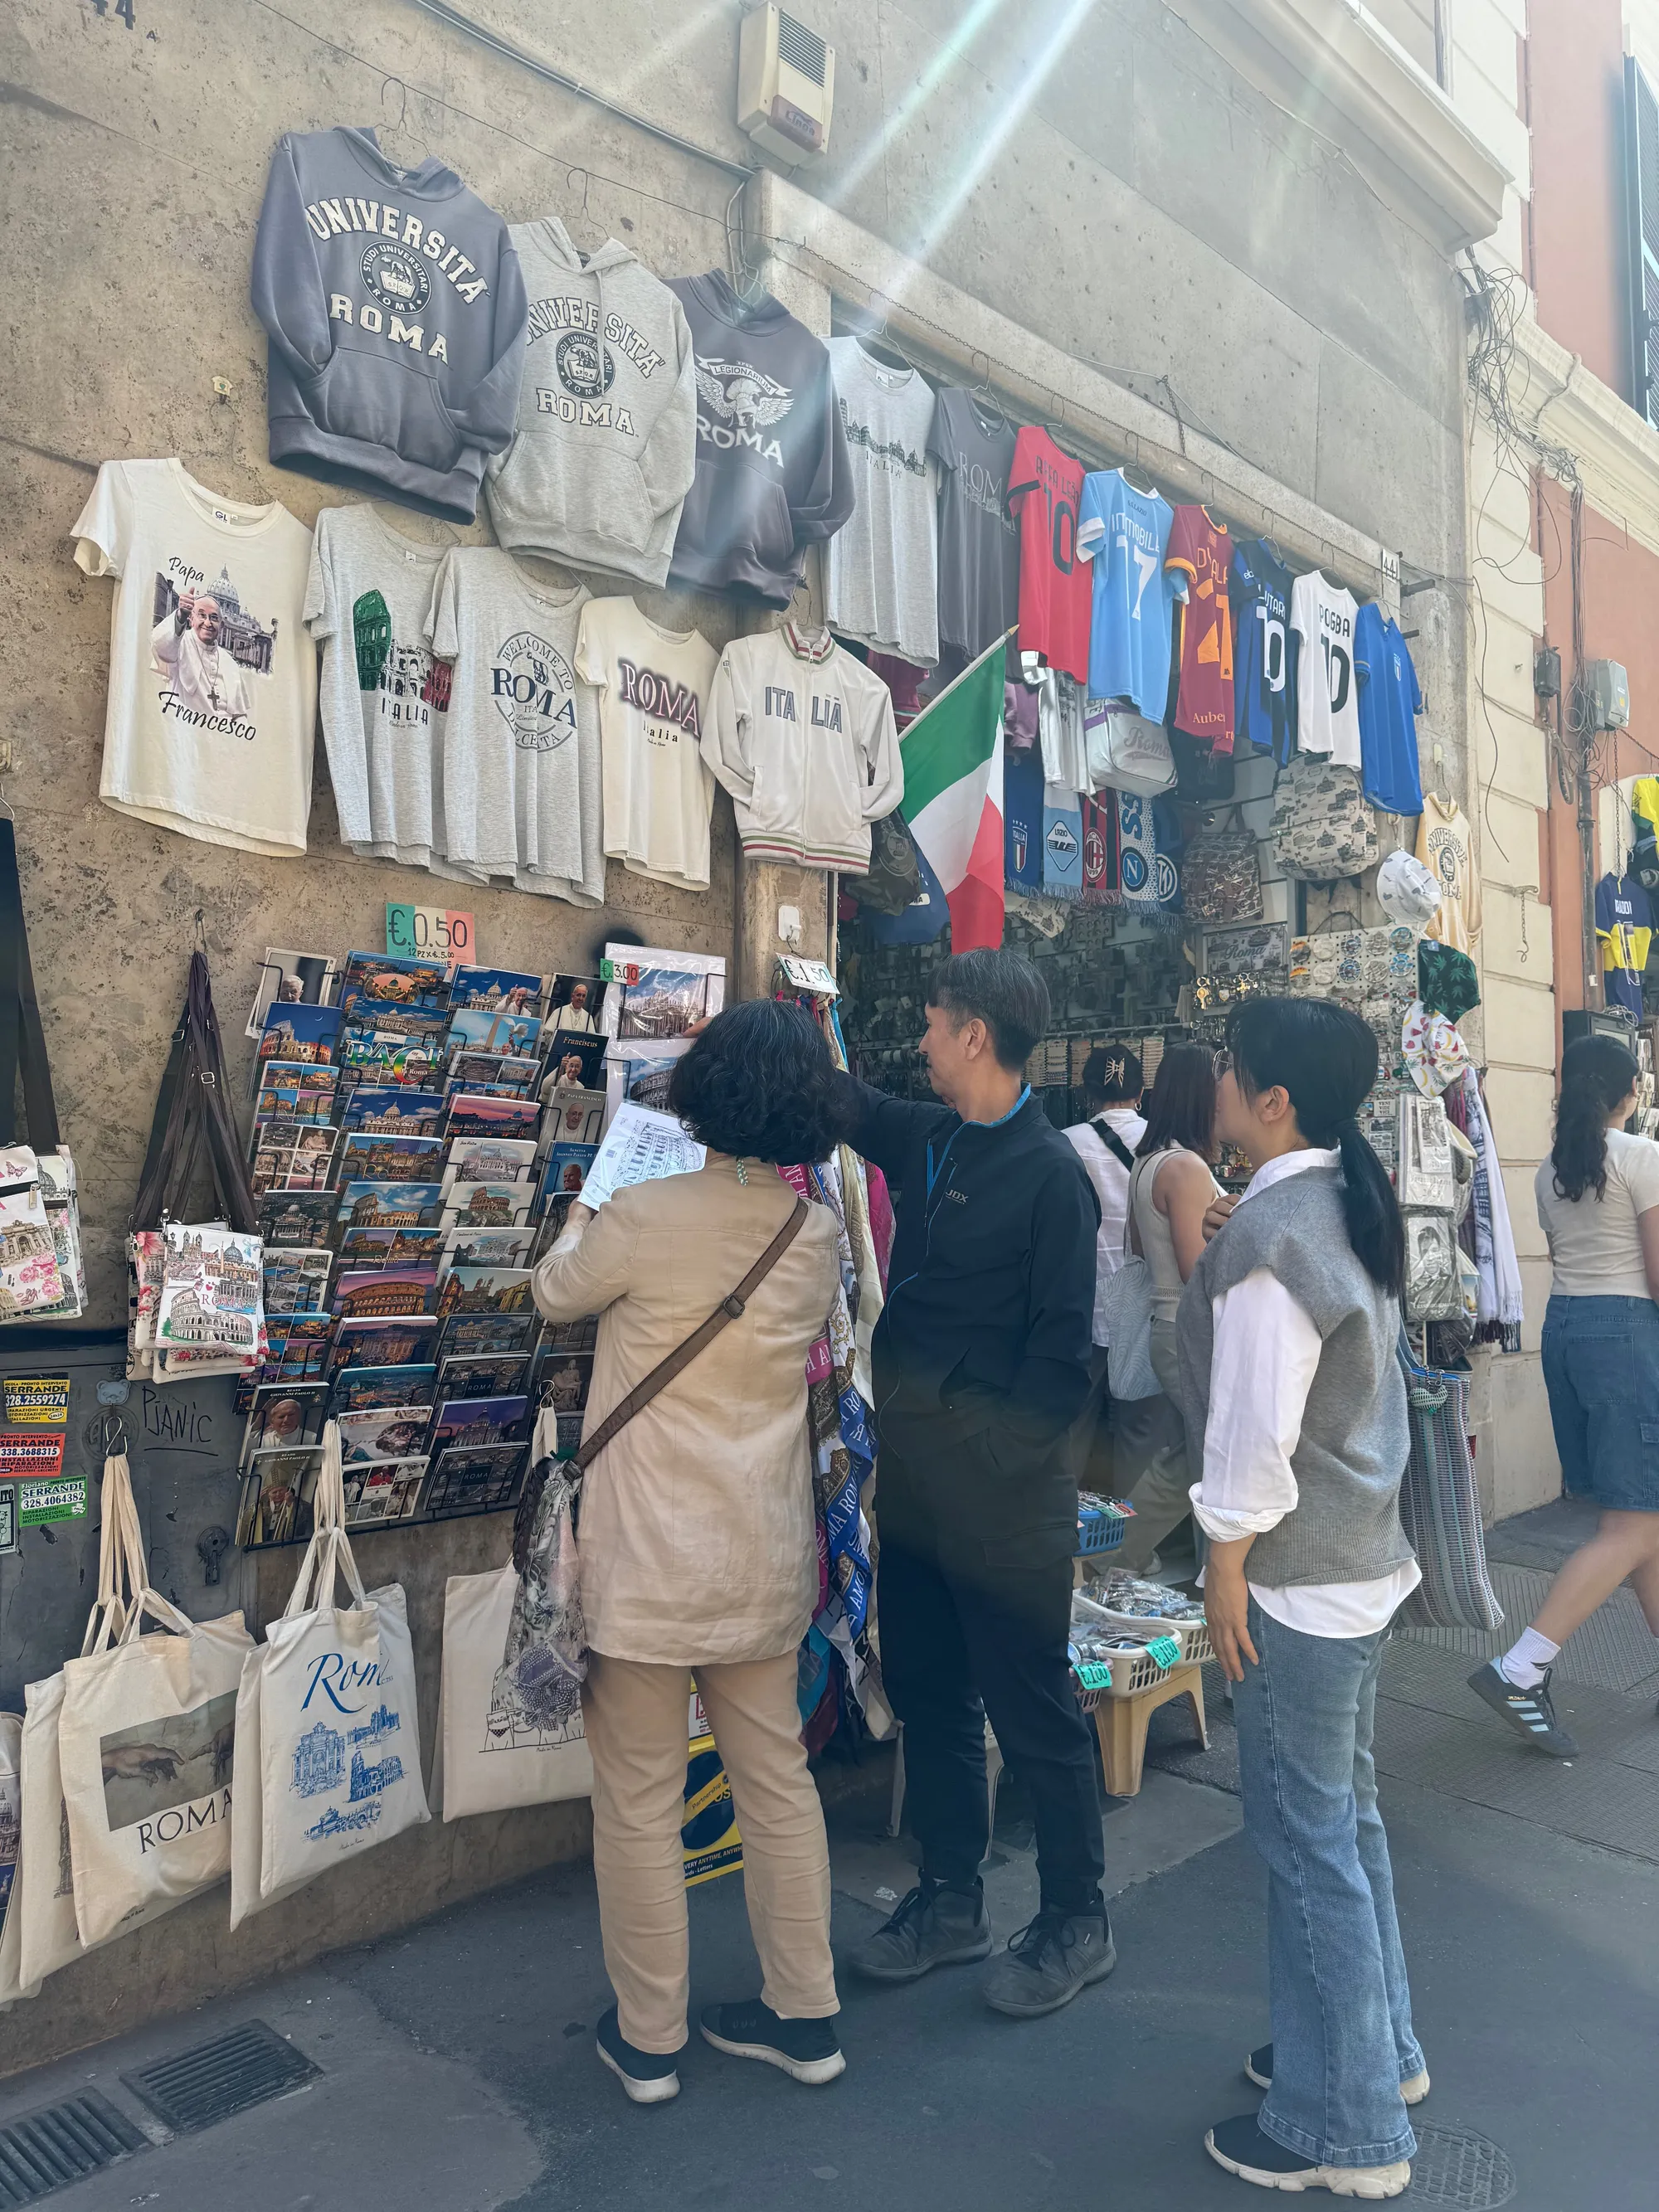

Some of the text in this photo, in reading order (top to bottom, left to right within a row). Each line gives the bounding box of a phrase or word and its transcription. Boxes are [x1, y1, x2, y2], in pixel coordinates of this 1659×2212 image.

[362, 246, 428, 292] STUDI UNIVERSITARI
[372, 289, 416, 312] ROMA
[329, 293, 449, 365] ROMA
[557, 335, 612, 373] STUDI UNIVERTARI
[565, 379, 602, 396] ROMA
[714, 366, 772, 392] LEGIONARIUM
[536, 387, 635, 435] ROMA
[697, 414, 784, 468] ROMA
[866, 450, 902, 479] ITALIA
[1044, 482, 1075, 576] 10
[168, 556, 205, 586] Papa
[1116, 534, 1158, 621] 17
[1319, 603, 1350, 638] POGBA
[502, 636, 573, 690] WELCOME TO
[1256, 605, 1286, 693] 10
[1321, 633, 1350, 713] 10
[490, 668, 578, 730] ROMA
[622, 663, 702, 739] ROMA
[158, 691, 256, 741] Francesco
[408, 947, 416, 956] 12
[417, 950, 425, 958] PZ
[1224, 944, 1267, 960] Roma
[562, 1036, 598, 1048] Franciscus
[5, 1393, 66, 1407] 328.2559274
[1, 1447, 58, 1456] 338.3688315
[22, 1481, 49, 1490] Floriano
[22, 1481, 85, 1499] SERRANDE
[22, 1506, 59, 1516] RIPARAZIONI
[22, 1510, 65, 1520] INSTALLAZIONI
[23, 1492, 84, 1509] 328.4064382
[22, 1513, 72, 1524] MOTORIZZAZIONI
[692, 1782, 722, 1810] Partnership
[136, 1787, 232, 1855] ROMA
[698, 1864, 713, 1873] Letters
